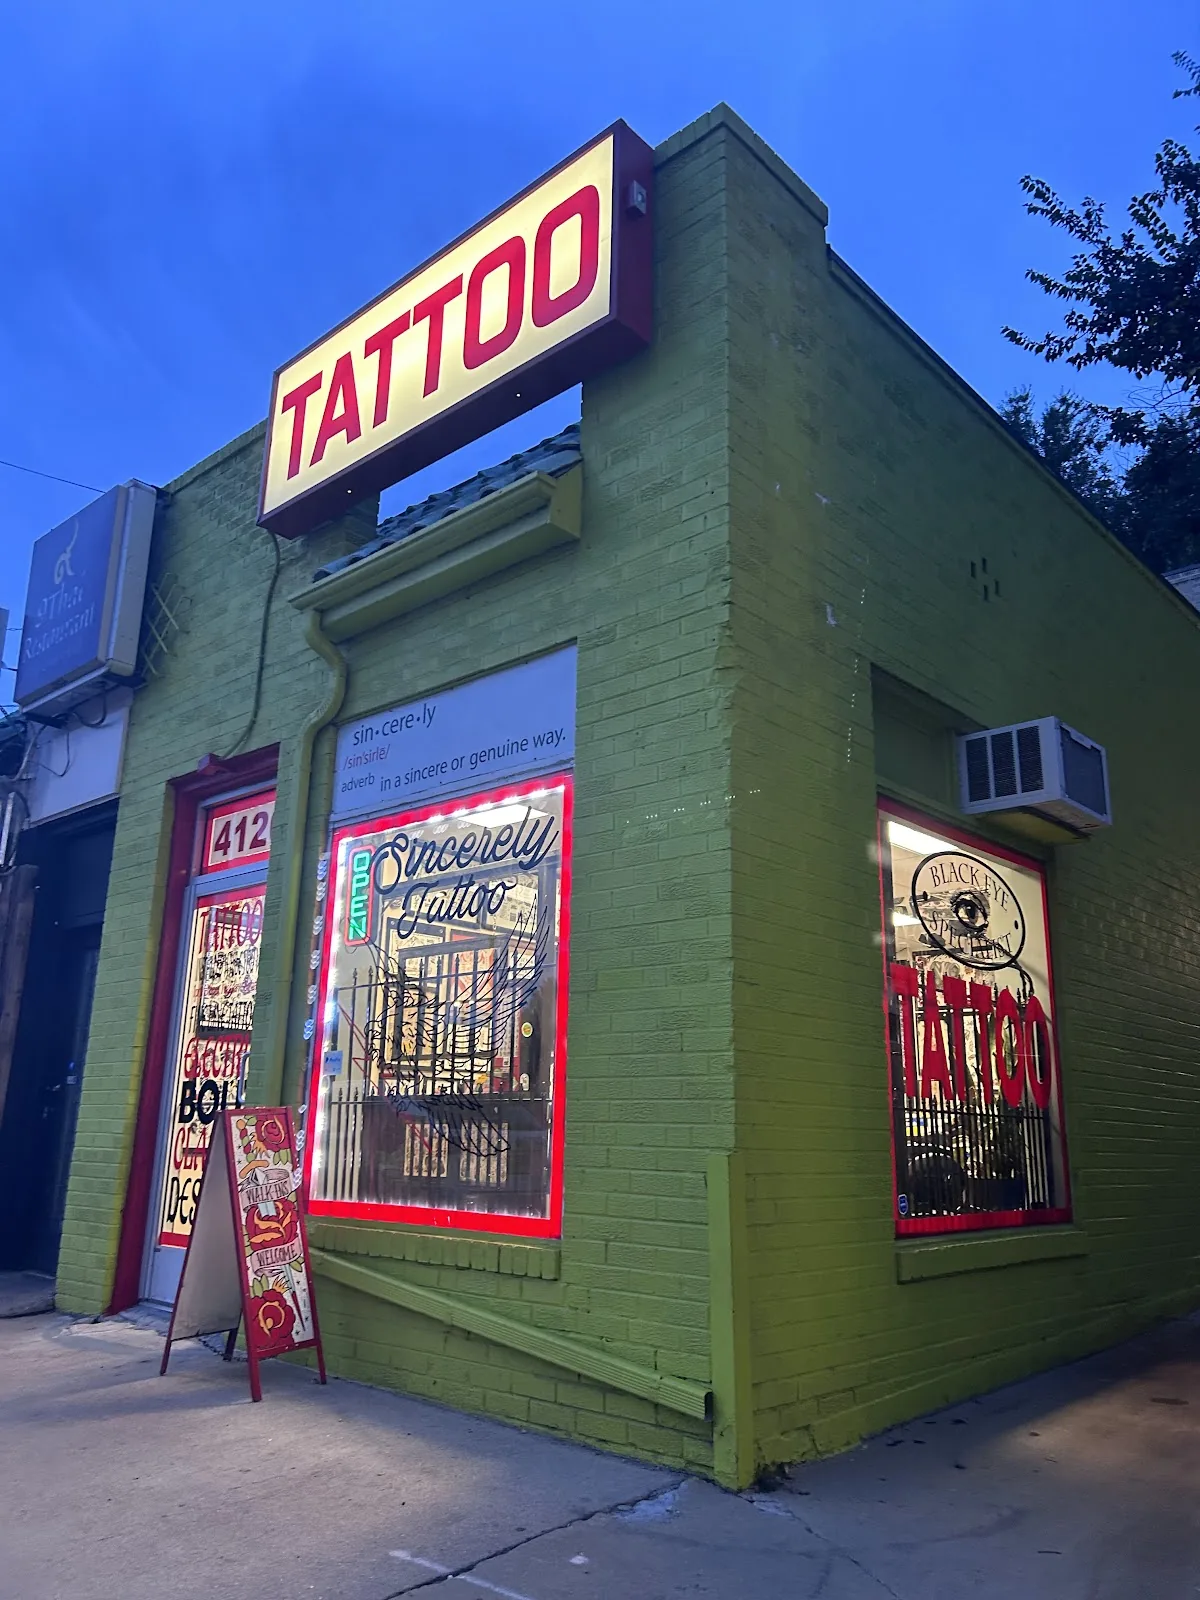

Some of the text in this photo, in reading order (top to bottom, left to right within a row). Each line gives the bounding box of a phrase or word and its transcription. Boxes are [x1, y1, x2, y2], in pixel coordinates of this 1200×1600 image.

[282, 184, 600, 480] TATTOO
[341, 728, 566, 792] adverb in a sincere or genuine way.
[213, 811, 269, 856] 412
[373, 806, 560, 895] Sincerely
[349, 852, 371, 940] OPEN
[397, 874, 517, 939] Tattoo
[929, 862, 1010, 912] BLACK EYE
[929, 910, 1013, 961] SPECIALIST
[890, 962, 1049, 1109] TATTOO
[246, 1181, 290, 1204] WALK-INS
[257, 1243, 298, 1267] WELCOME
